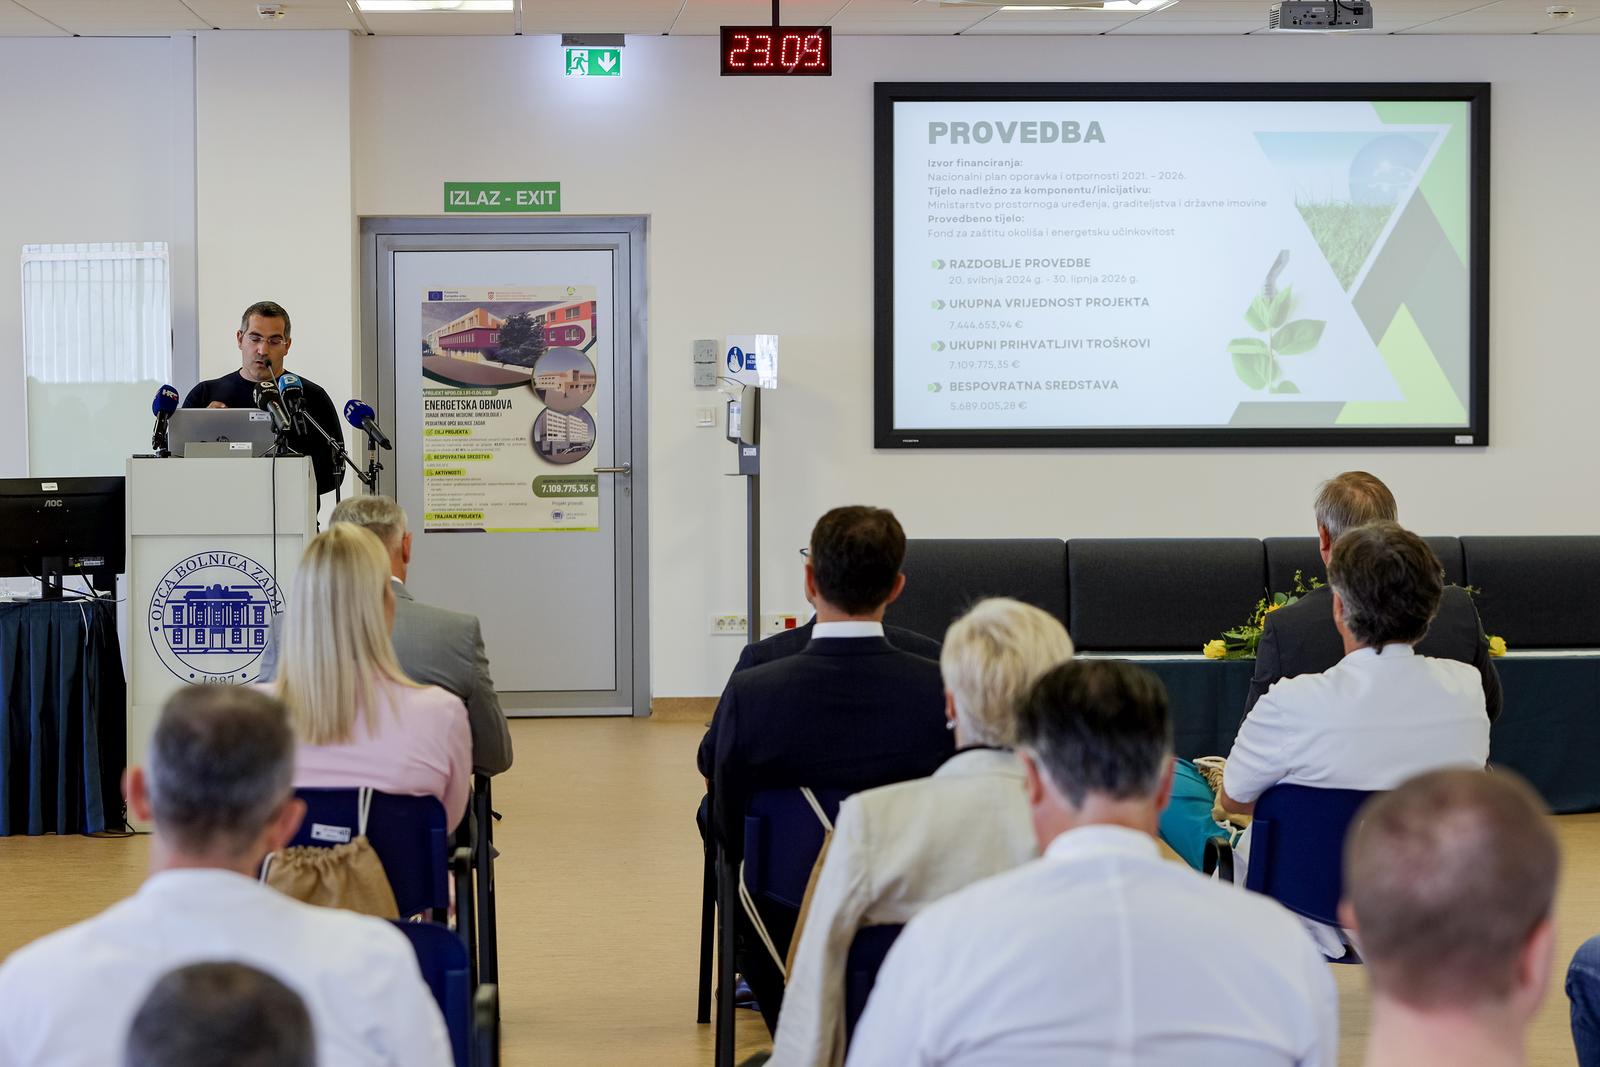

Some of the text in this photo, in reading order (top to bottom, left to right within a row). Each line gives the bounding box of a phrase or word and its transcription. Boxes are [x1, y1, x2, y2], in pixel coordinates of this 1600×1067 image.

[730, 35, 825, 67] 23.09.
[928, 121, 1106, 144] PROVEDBA
[928, 158, 1023, 169] Izvor financiranja:
[928, 172, 982, 182] Nacionalni
[985, 172, 1008, 184] plan
[1009, 172, 1057, 184] oporavka
[1065, 171, 1120, 183] otpornosti
[1122, 170, 1148, 180] 2021.
[1158, 170, 1186, 180] 2026.
[928, 186, 957, 198] Tijelo
[959, 186, 1008, 196] nadležno
[1023, 185, 1151, 197] komponentu/inicijativu:
[449, 190, 500, 206] IZLAZ
[516, 190, 557, 206] EXIT
[928, 200, 992, 209] Ministarstvo
[994, 200, 1059, 211] prostornoga
[1061, 199, 1110, 210] uređenja,
[1112, 198, 1177, 210] graditeljstva
[1184, 198, 1224, 208] državne
[1226, 198, 1267, 207] imovine
[928, 214, 1025, 226] Provedbeno tijelo:
[928, 229, 953, 239] Fond
[970, 228, 1005, 238] zaštitu
[1007, 228, 1043, 238] okoliša
[1051, 228, 1110, 240] energetsku
[1112, 227, 1175, 237] učinkovitost
[950, 258, 1091, 269] RAZDOBLJE PROVEDBE
[949, 275, 965, 285] 20.
[967, 274, 1003, 286] svibnja
[1006, 274, 1032, 284] 2024
[1034, 276, 1043, 286] g.
[1053, 274, 1069, 284] 30.
[1071, 274, 1098, 285] lipnja
[1101, 274, 1127, 283] 2026
[1129, 276, 1139, 285] g.
[950, 297, 1149, 309] UKUPNA VRIJEDNOST PROJEKTA
[1014, 320, 1023, 329] €
[949, 337, 1151, 350] UKUPNI PRIHVATLJIVI TROŠKOVI
[1011, 360, 1020, 368] €
[950, 380, 1119, 391] BESPOVRATNA SREDSTAVA
[425, 400, 512, 411] ENERGETSKA OBNOVA
[1018, 402, 1027, 410] €
[541, 484, 596, 494] 7.109.775,35 €
[174, 553, 249, 579] BOLNICA
[202, 674, 236, 685] 1887
